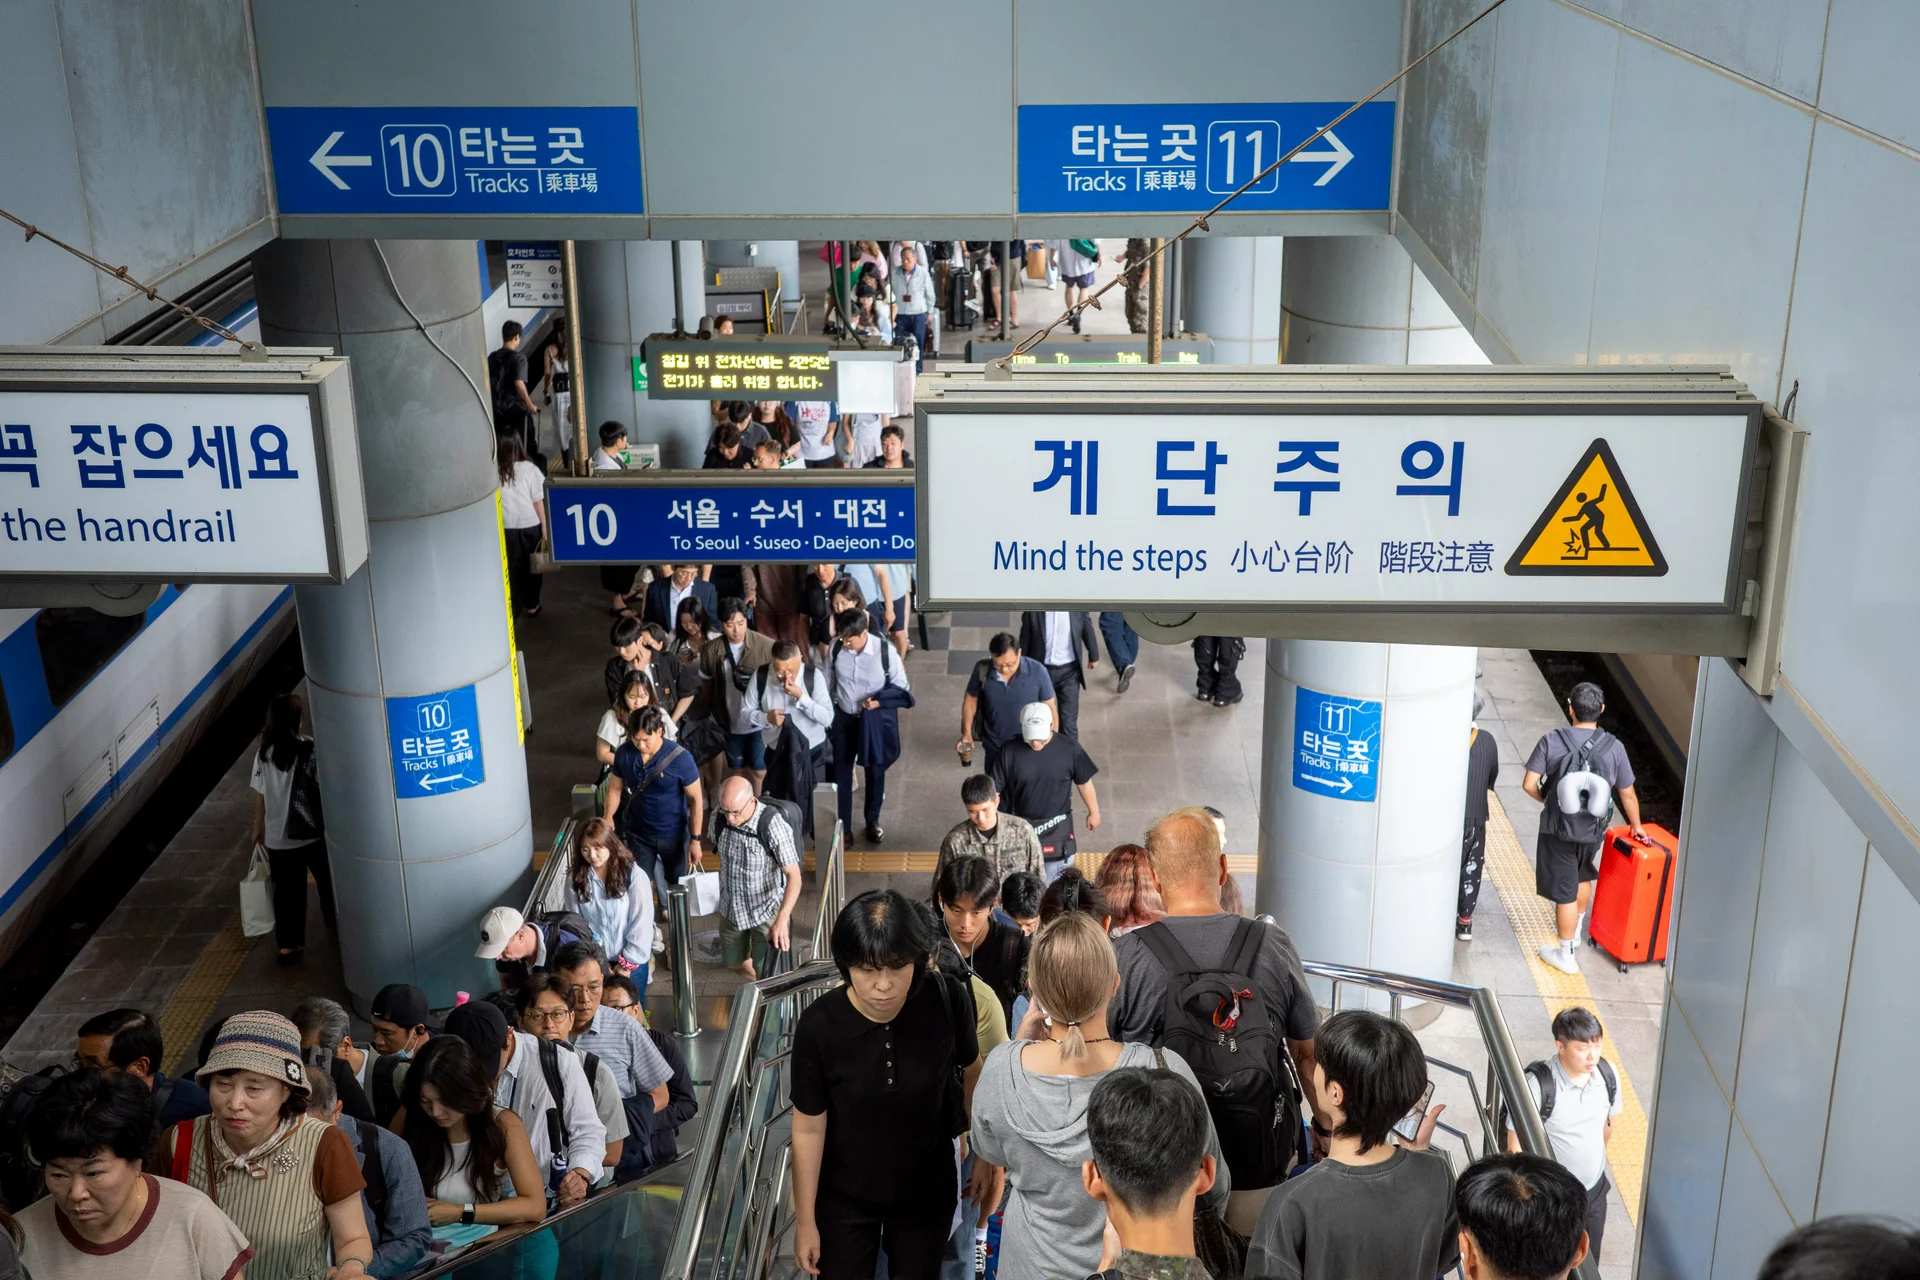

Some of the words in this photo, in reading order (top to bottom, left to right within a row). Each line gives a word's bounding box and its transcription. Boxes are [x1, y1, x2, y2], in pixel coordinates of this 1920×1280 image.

[458, 127, 537, 165] 타는
[547, 127, 585, 165] 곳
[1071, 124, 1150, 163] 타는
[1160, 124, 1198, 162] 곳
[1218, 130, 1264, 185] 11
[389, 132, 446, 189] 10
[464, 172, 530, 194] Tracks
[1061, 170, 1127, 192] Tracks
[695, 356, 710, 369] 위
[1055, 353, 1069, 365] To
[1117, 352, 1142, 364] Train
[662, 374, 705, 389] 전기가
[742, 376, 770, 389] 위험
[70, 423, 299, 489] 잡으세요
[1, 507, 66, 542] the
[76, 508, 236, 543] handrail
[566, 503, 618, 546] 10
[667, 498, 720, 528] 서울
[750, 499, 804, 529] 수서
[833, 499, 887, 528] 대전
[670, 536, 690, 550] To
[695, 535, 740, 550] Seoul
[753, 535, 801, 550] Suseo
[813, 535, 880, 553] Daejeon
[1230, 540, 1354, 574] 小心台阶
[1379, 540, 1495, 574] 階段注意
[993, 540, 1067, 571] Mind
[1076, 540, 1124, 571] the
[1132, 544, 1207, 579] steps
[421, 704, 446, 729] 10
[1325, 706, 1344, 731] 11
[402, 736, 445, 757] 타는
[450, 728, 470, 751] 곳
[1303, 730, 1341, 758] 타는
[1347, 740, 1369, 760] 곳
[402, 758, 438, 771] Tracks
[1300, 752, 1331, 770] Tracks
